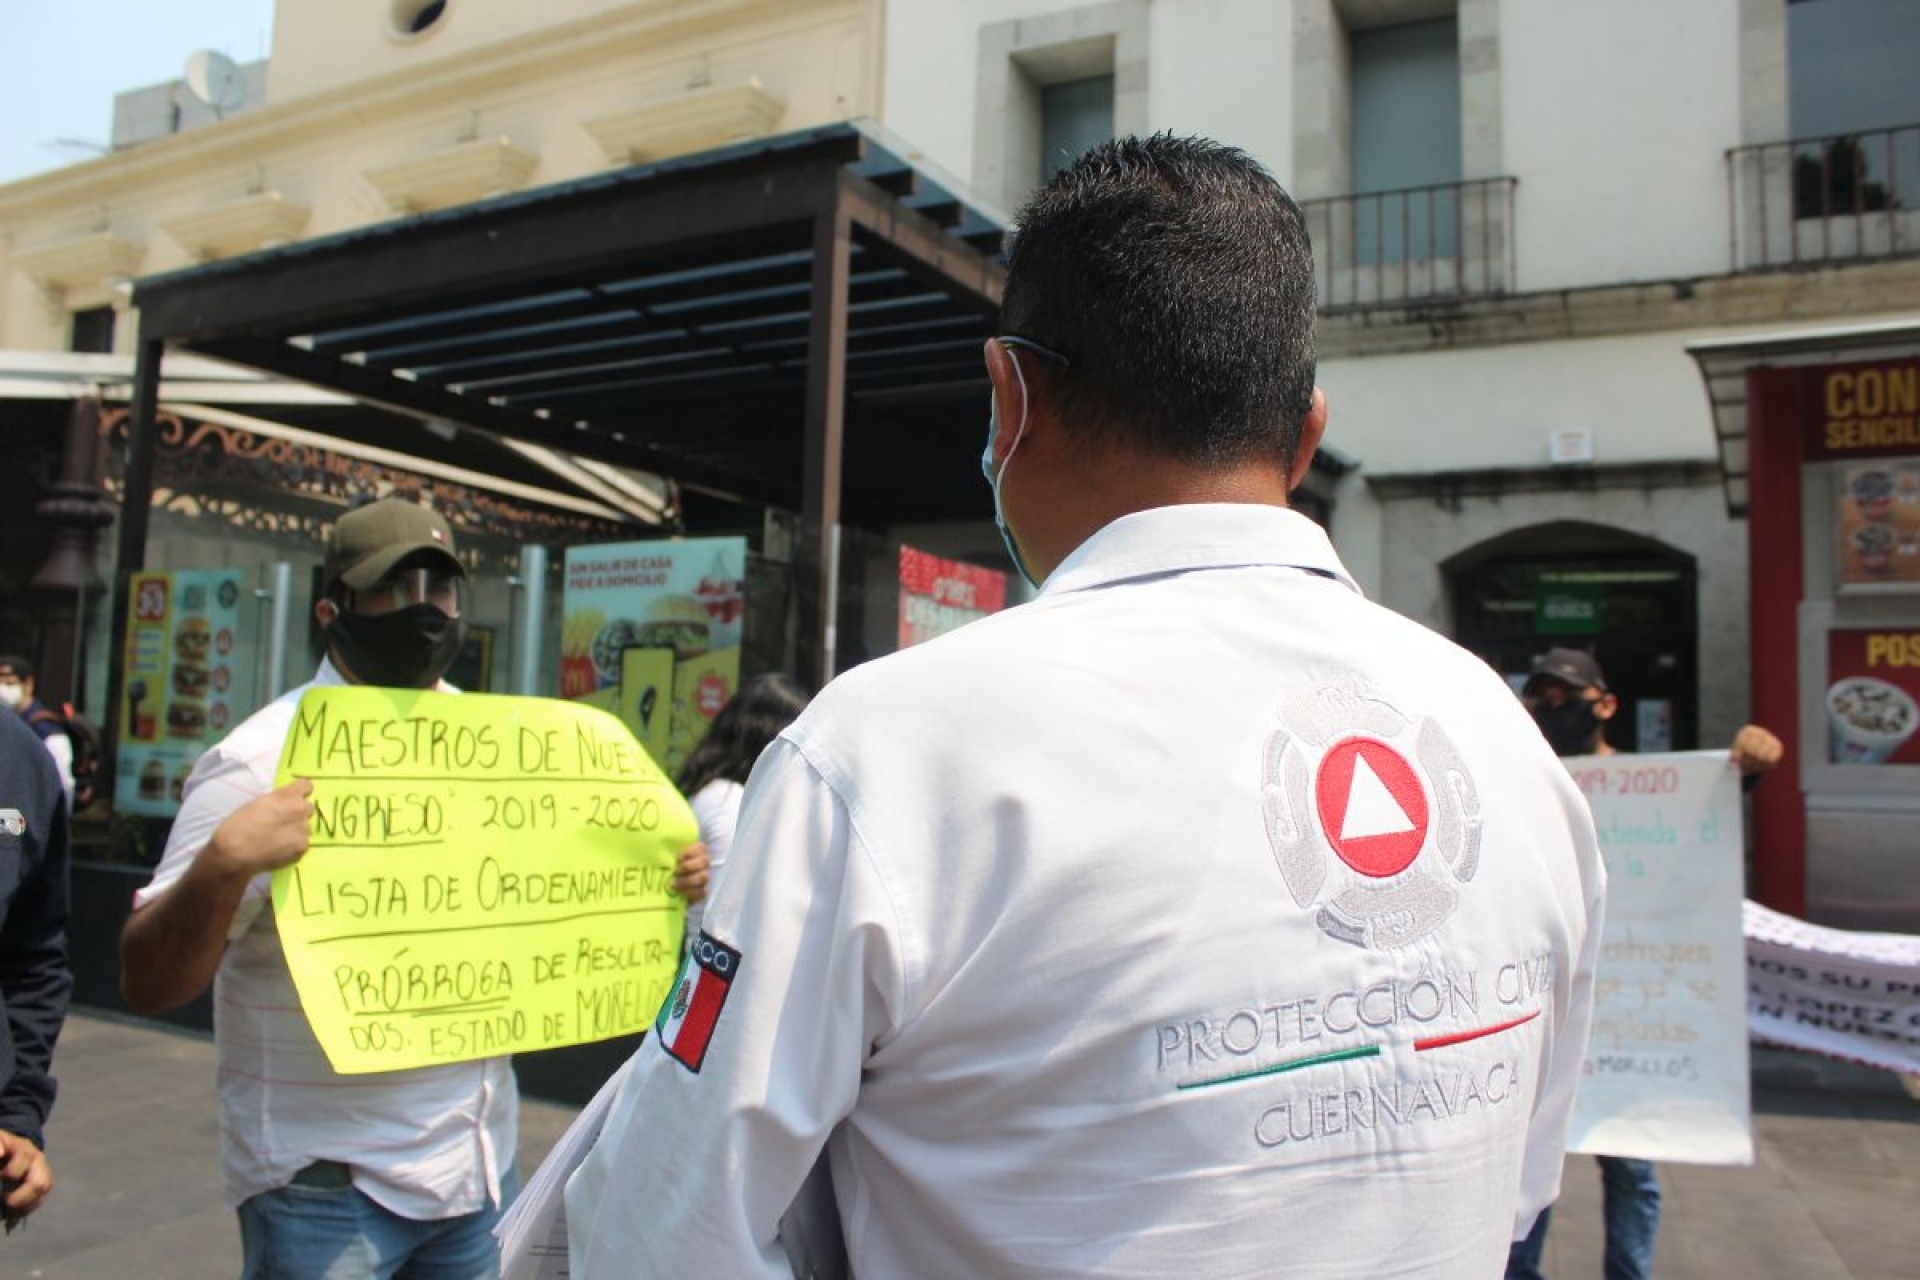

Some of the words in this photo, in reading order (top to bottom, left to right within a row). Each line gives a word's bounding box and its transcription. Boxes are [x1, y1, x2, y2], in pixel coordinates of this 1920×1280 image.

[287, 700, 500, 775] MAESTROS
[519, 726, 562, 772] DE
[296, 866, 408, 918] LISTA
[423, 878, 462, 912] DE
[334, 946, 512, 1013] PRÓRROGA
[532, 953, 565, 984] DE
[430, 1010, 526, 1057] ESTADO
[543, 1014, 566, 1043] DE
[576, 977, 666, 1041] MORELO
[1254, 1058, 1520, 1148] CUERNAVACA
